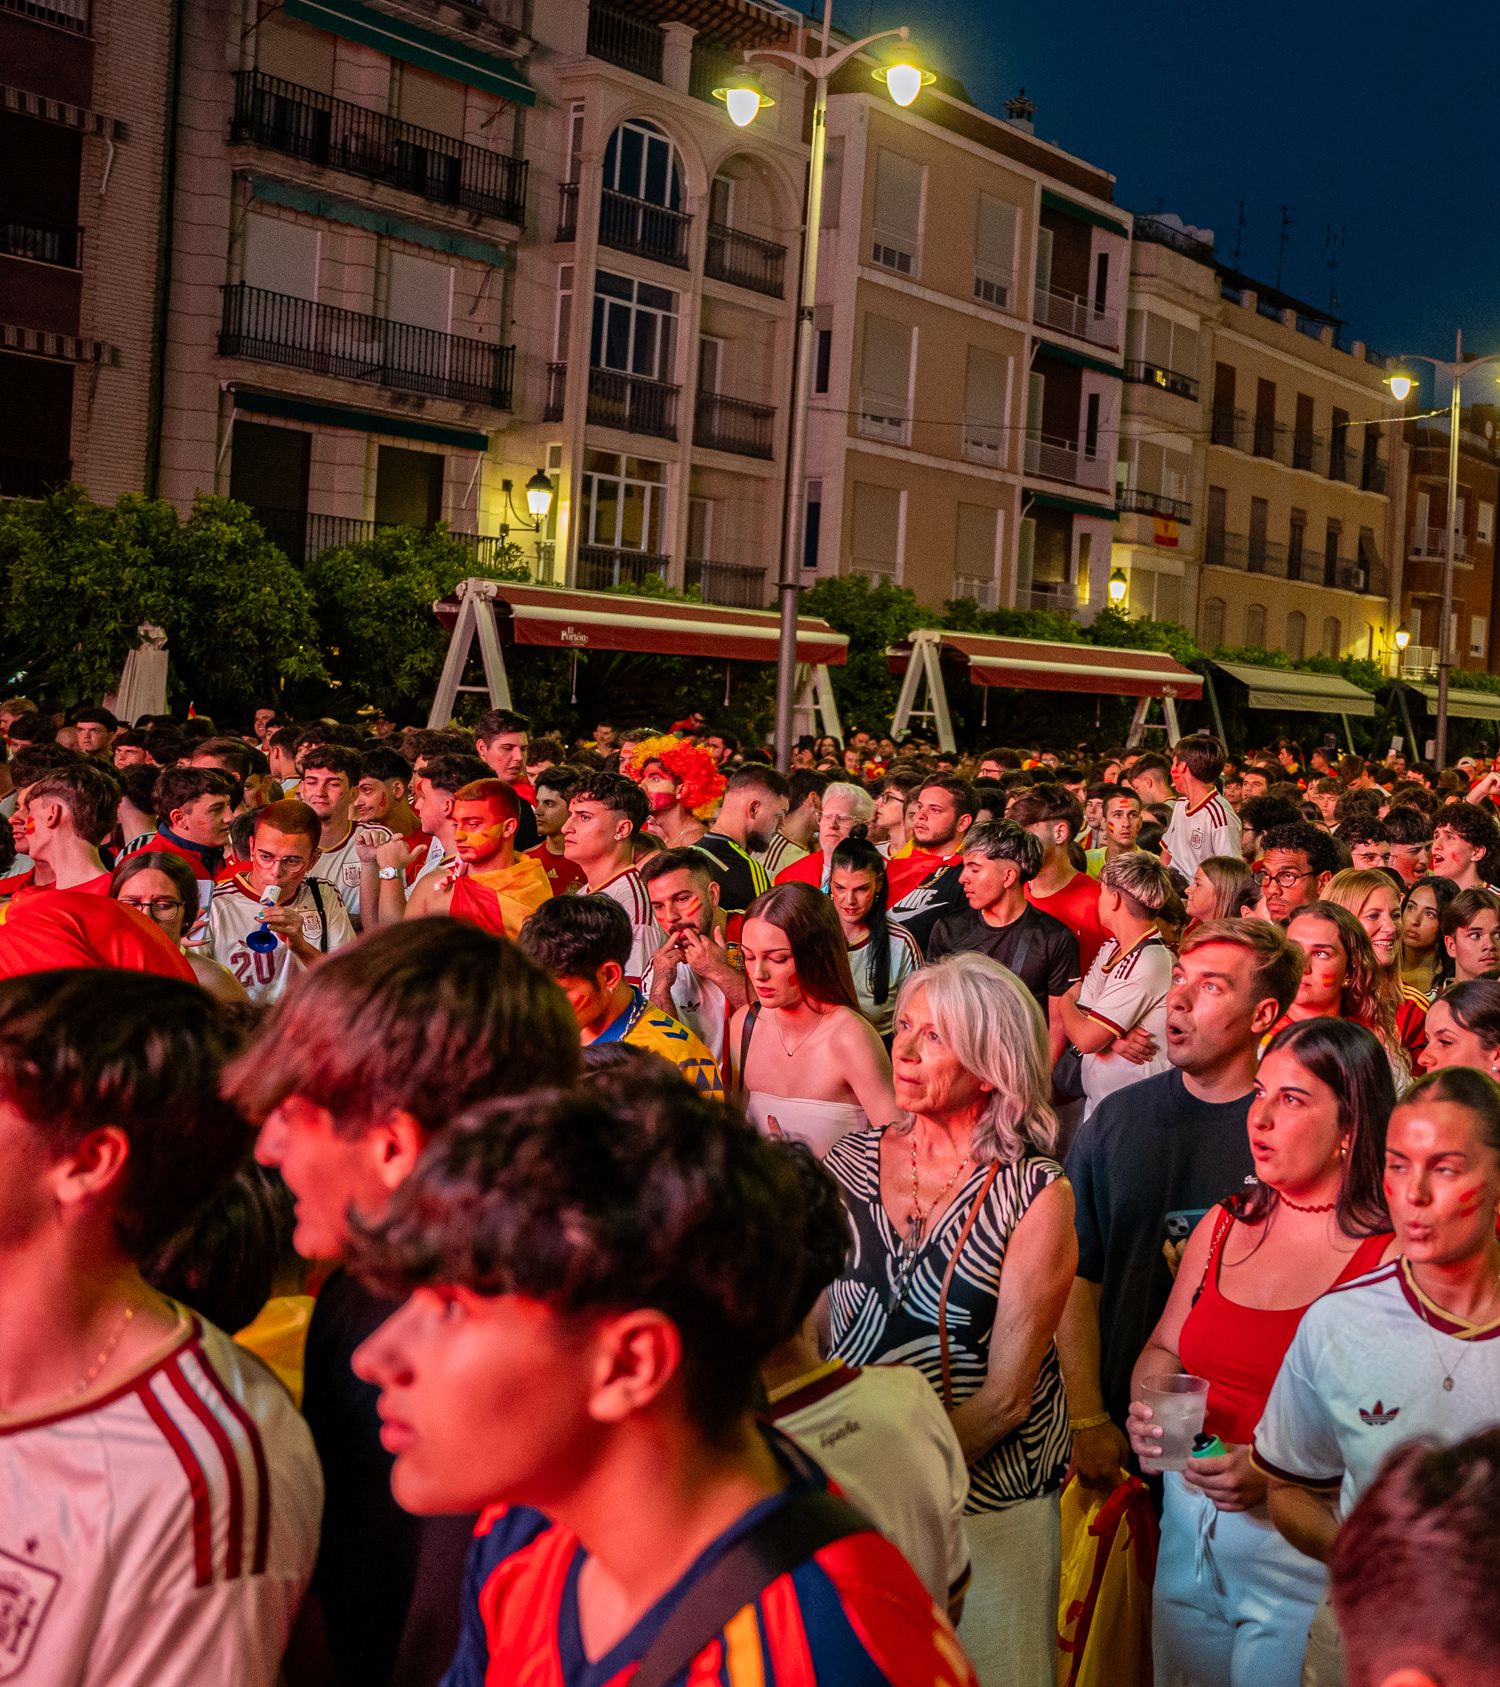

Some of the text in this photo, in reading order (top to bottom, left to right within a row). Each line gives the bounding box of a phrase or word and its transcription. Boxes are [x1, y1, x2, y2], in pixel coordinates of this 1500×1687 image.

[568, 626, 574, 634] El
[893, 889, 939, 909] NIKE
[230, 950, 275, 988] 20
